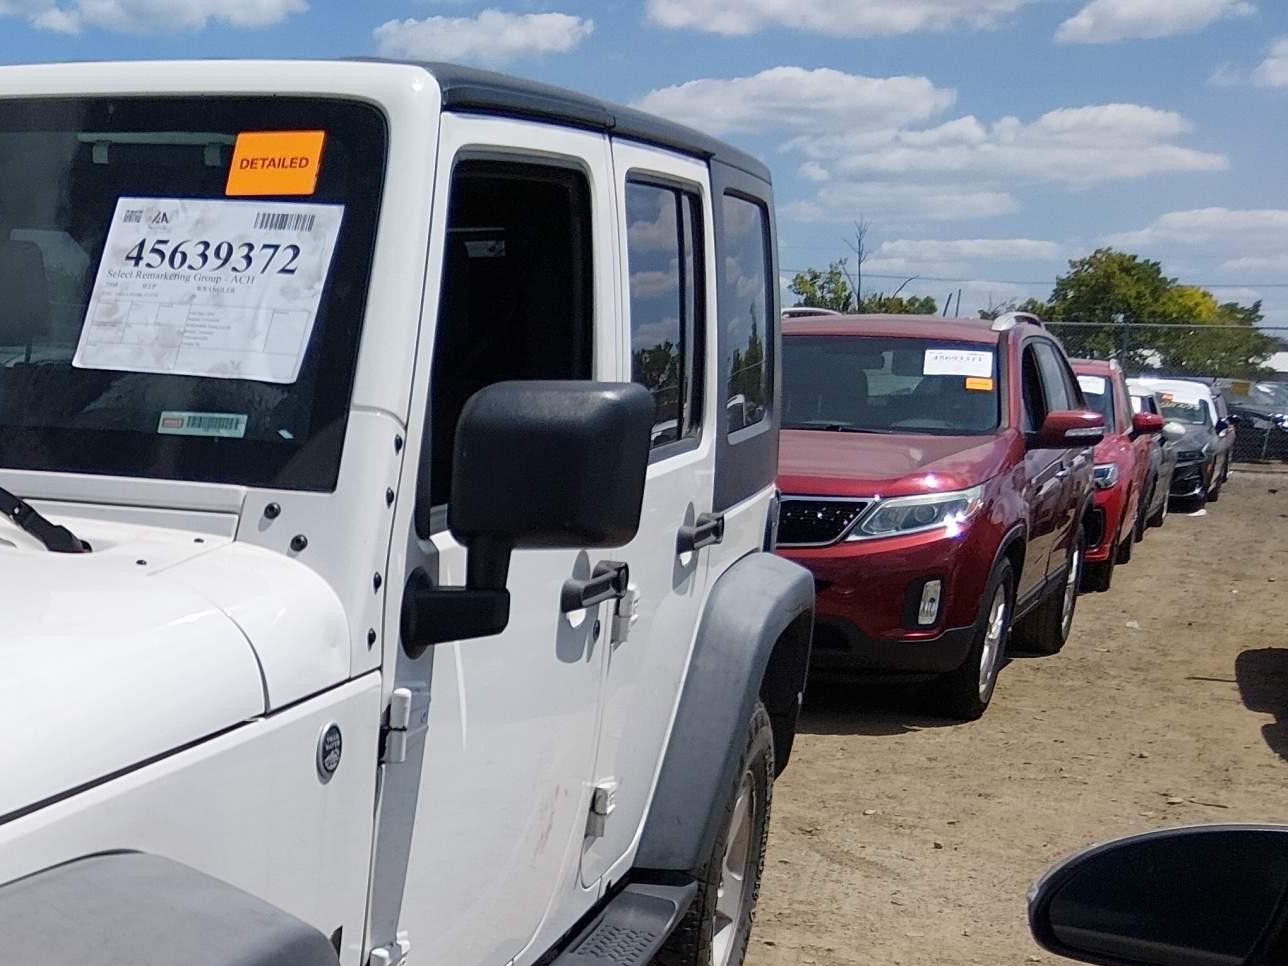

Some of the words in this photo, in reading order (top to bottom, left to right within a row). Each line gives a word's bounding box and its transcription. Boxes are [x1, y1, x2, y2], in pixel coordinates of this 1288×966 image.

[239, 156, 310, 170] DETAILED
[124, 237, 301, 276] 45639372
[106, 270, 133, 279] Select
[193, 273, 222, 284] Group
